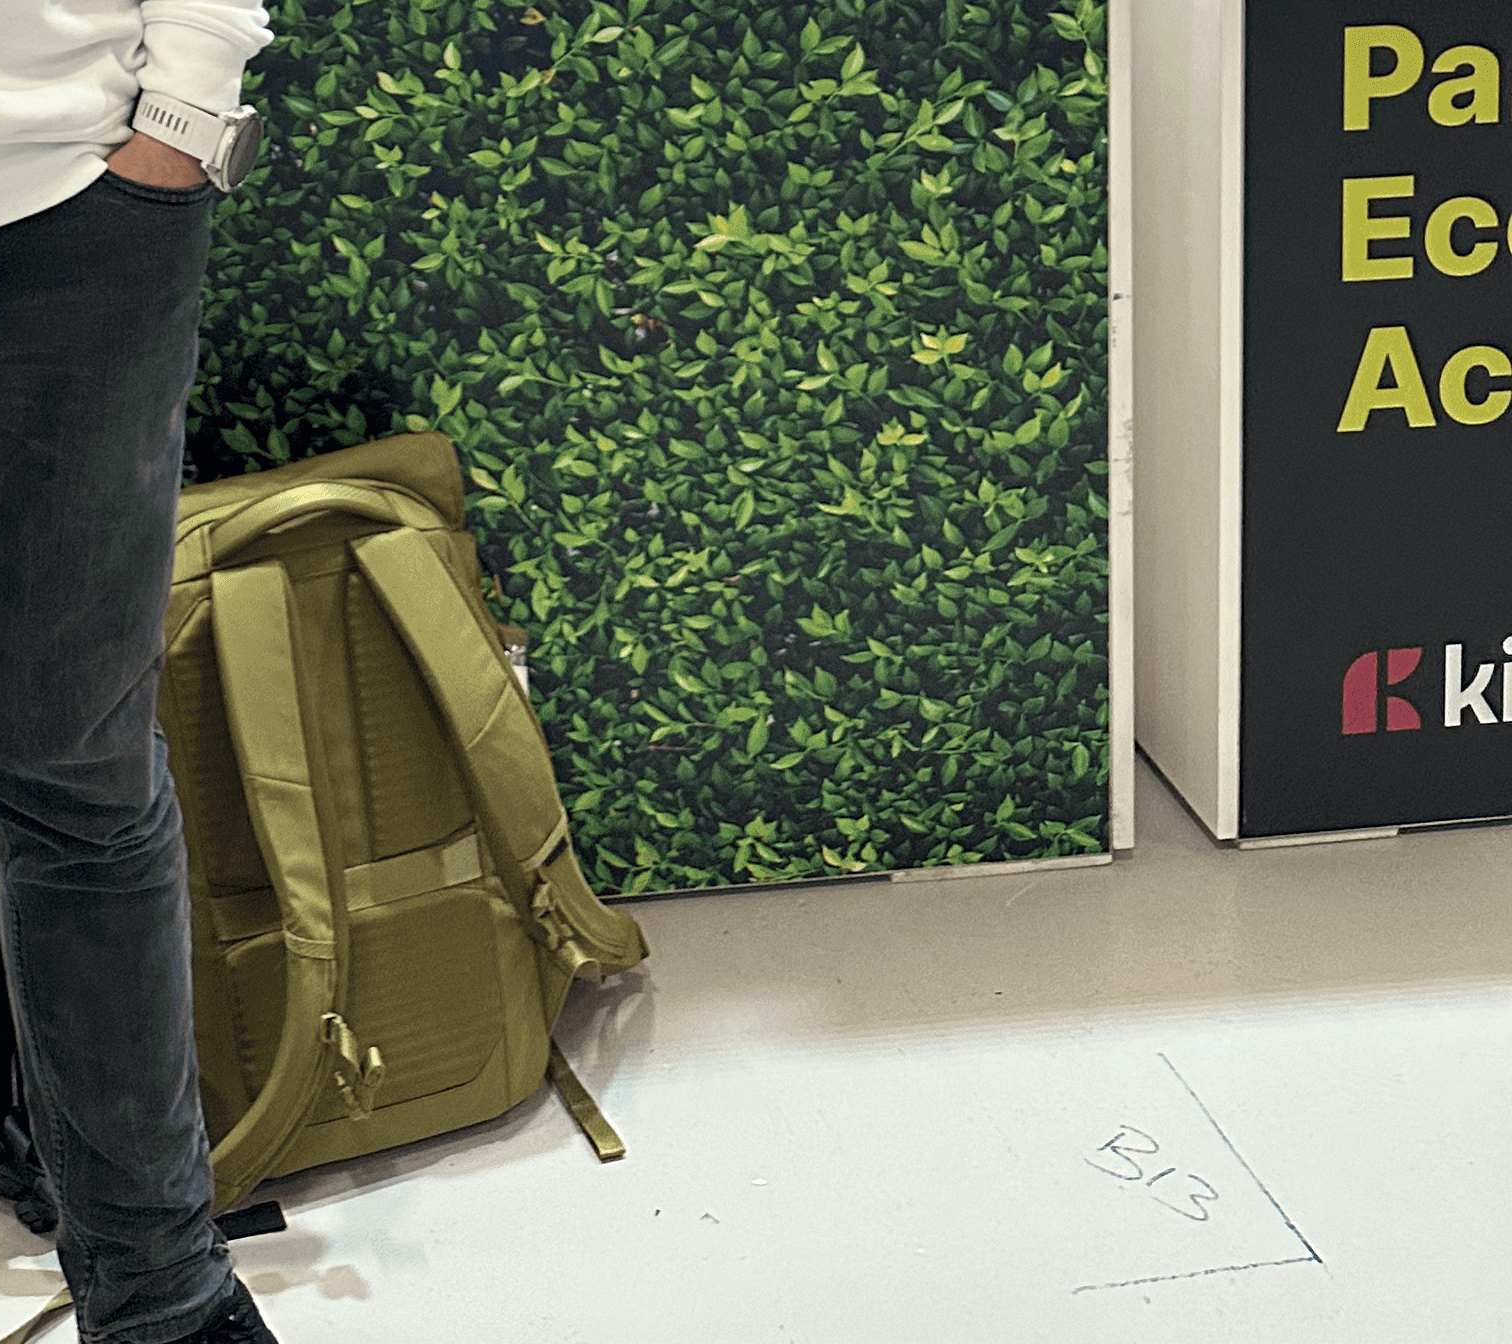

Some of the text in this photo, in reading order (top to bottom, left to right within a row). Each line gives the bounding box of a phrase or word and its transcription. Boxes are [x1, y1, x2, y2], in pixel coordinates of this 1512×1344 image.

[1343, 25, 1501, 131] Pa
[1341, 175, 1512, 282] Ec
[1336, 326, 1512, 433] Ac
[1084, 1125, 1219, 1222] B13
